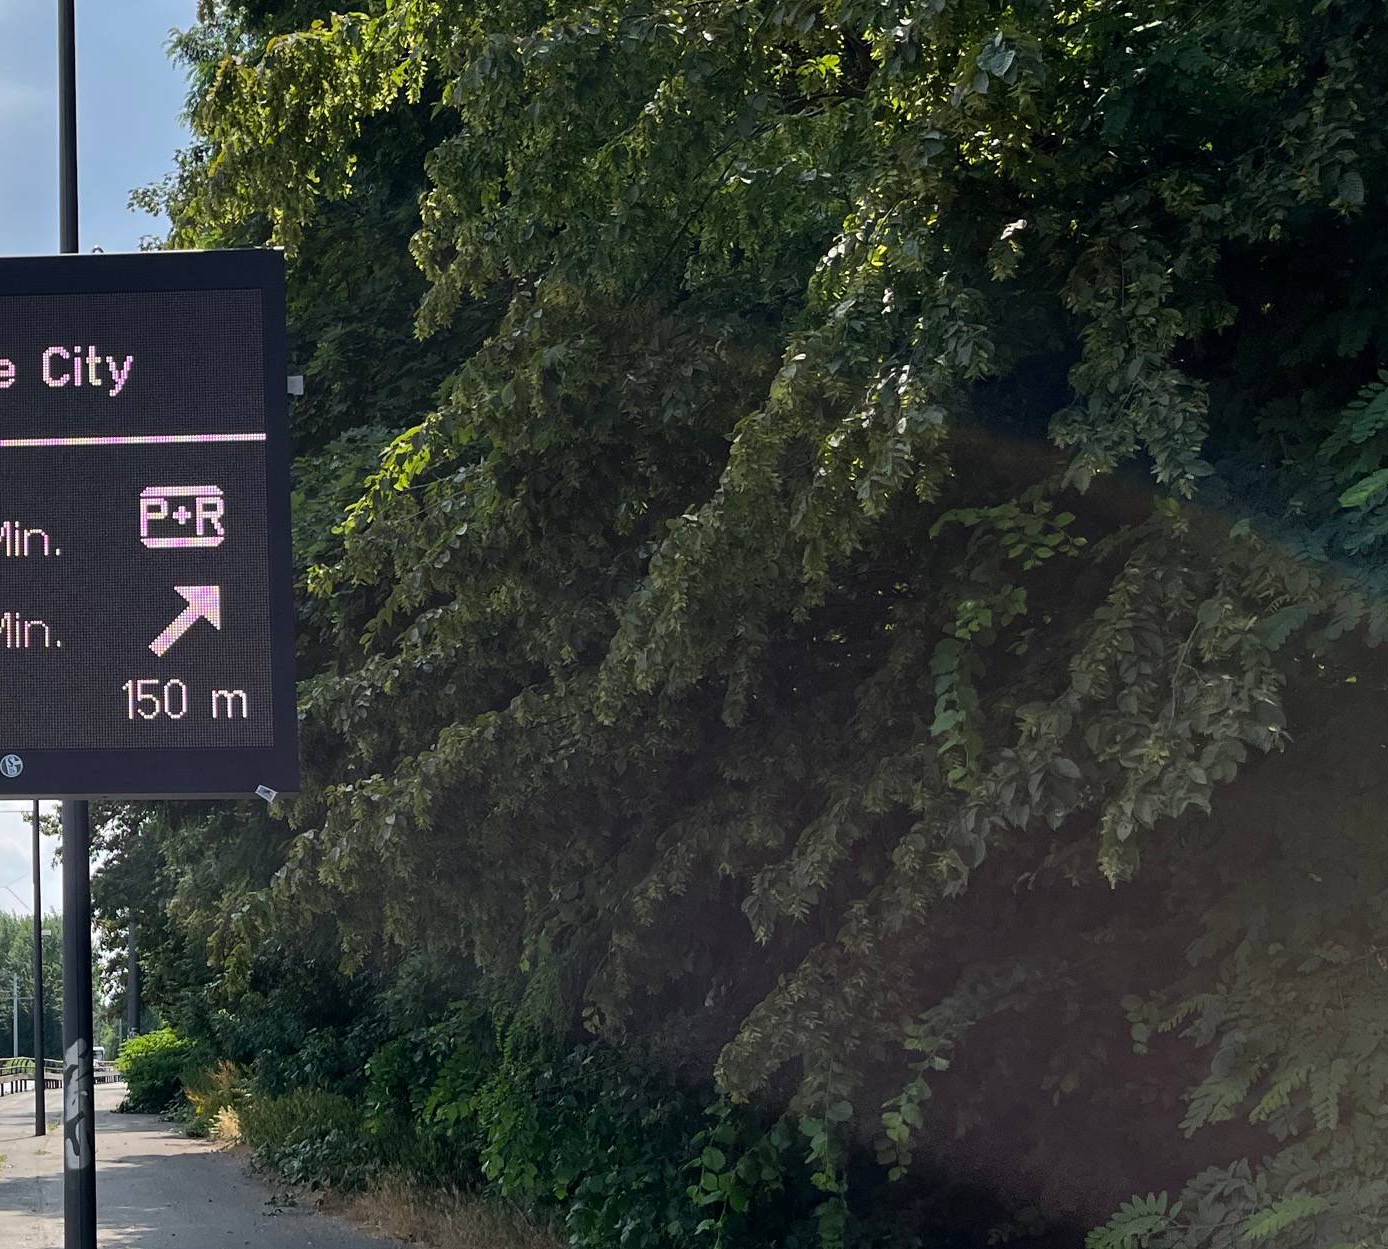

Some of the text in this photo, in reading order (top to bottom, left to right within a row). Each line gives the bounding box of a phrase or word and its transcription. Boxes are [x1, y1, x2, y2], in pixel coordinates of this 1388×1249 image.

[42, 345, 134, 397] City
[140, 496, 224, 536] P+R
[121, 678, 248, 720] 150 m
